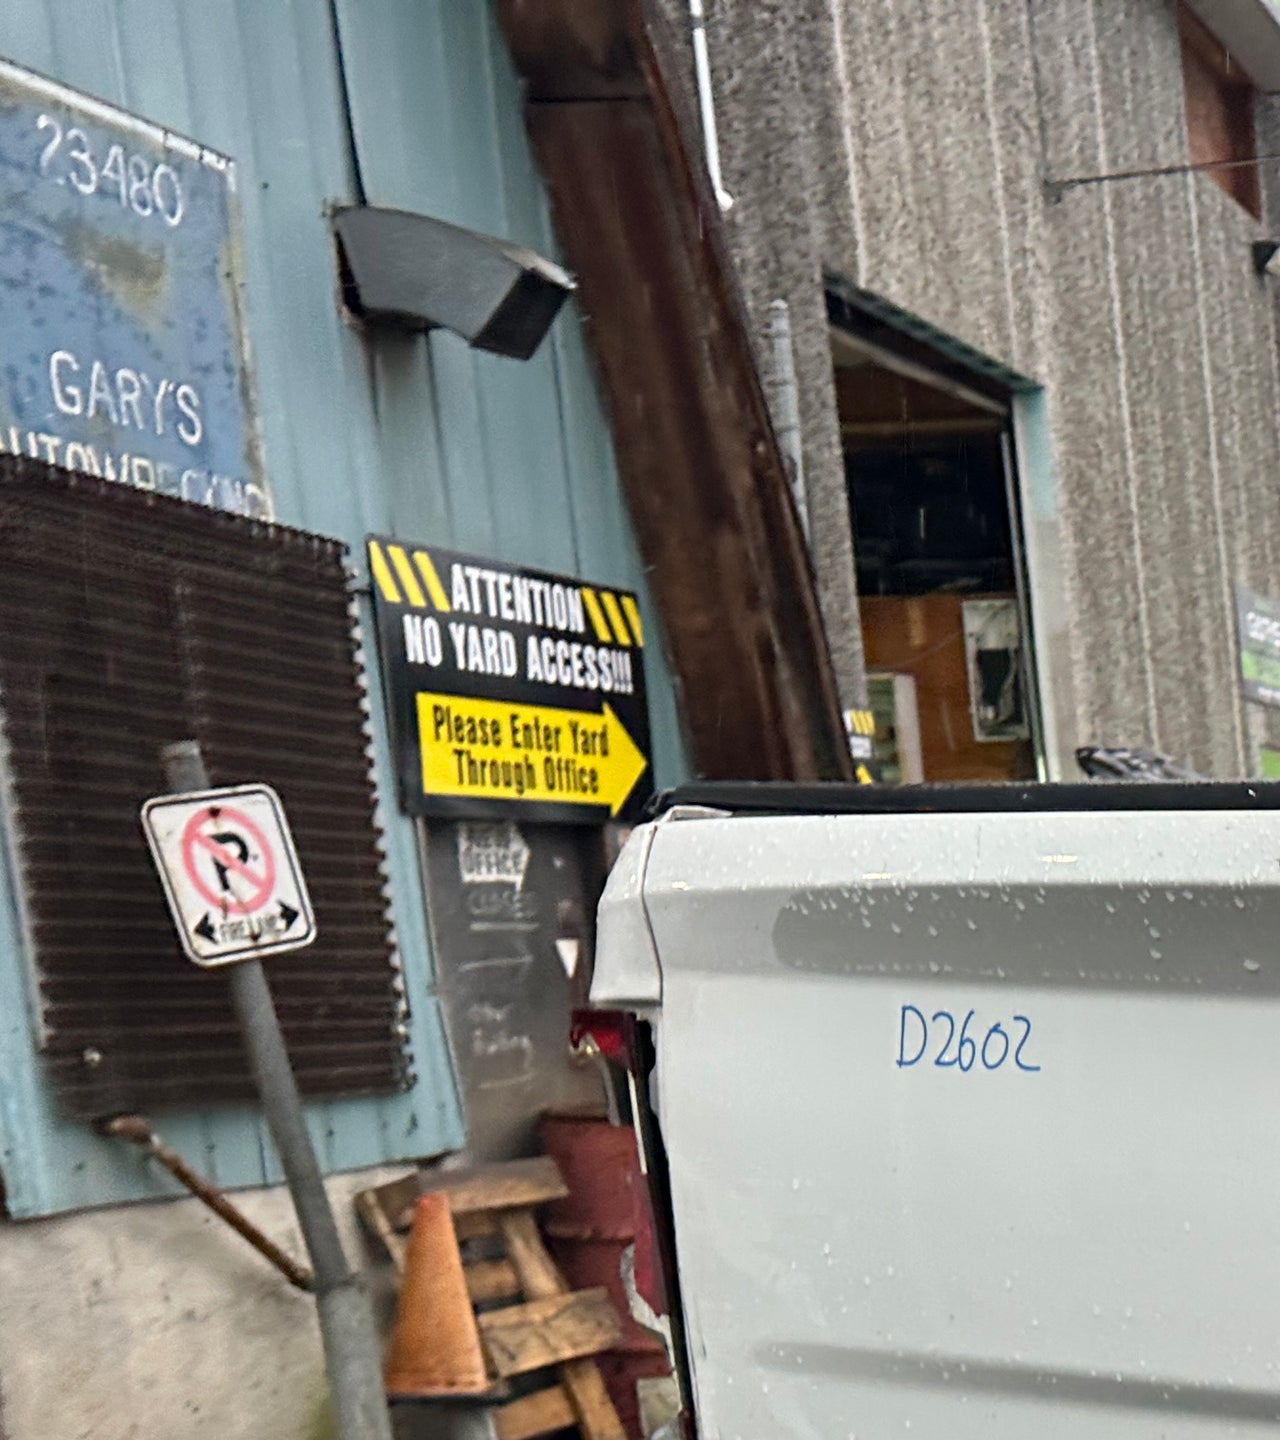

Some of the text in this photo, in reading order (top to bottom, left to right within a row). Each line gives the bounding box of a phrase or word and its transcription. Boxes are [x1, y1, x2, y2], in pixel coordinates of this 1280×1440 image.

[36, 114, 184, 226] 23480
[50, 350, 202, 446] GARY'S
[451, 563, 586, 634] ATTENTION
[403, 614, 634, 694] NO YARD ACCESS!!!
[432, 704, 609, 758] Please Enter Yard
[453, 748, 600, 796] Through Office
[896, 1005, 1041, 1071] D2602
